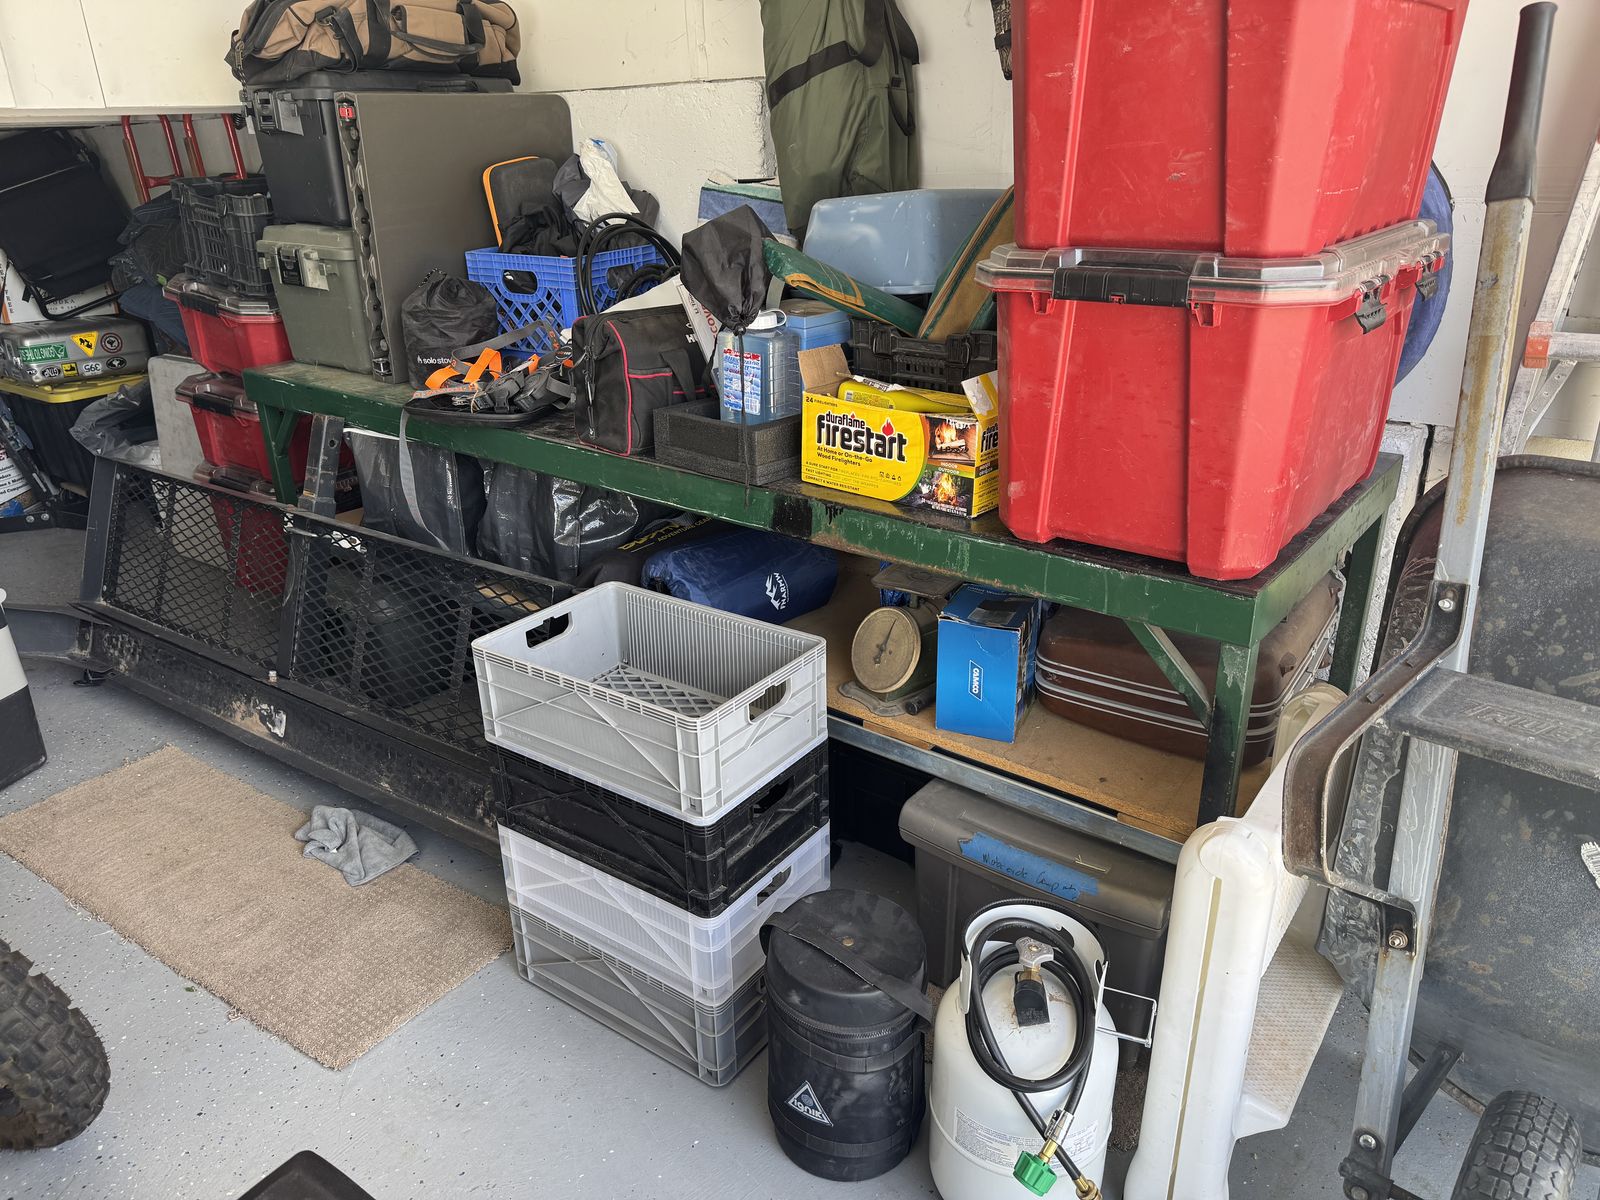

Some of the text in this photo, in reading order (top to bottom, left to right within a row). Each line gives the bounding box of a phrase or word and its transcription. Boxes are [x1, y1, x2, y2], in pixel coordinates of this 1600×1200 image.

[84, 363, 101, 373] 395
[423, 356, 452, 365] solo stov
[825, 411, 865, 430] duraflame
[816, 414, 907, 462] firestart
[817, 451, 861, 467] Wood Firelighters
[823, 447, 838, 457] Home
[844, 452, 873, 463] On-the-Go
[657, 524, 695, 542] ADVENTURE
[971, 667, 979, 694] CAMCO
[793, 1099, 823, 1119] ignik
